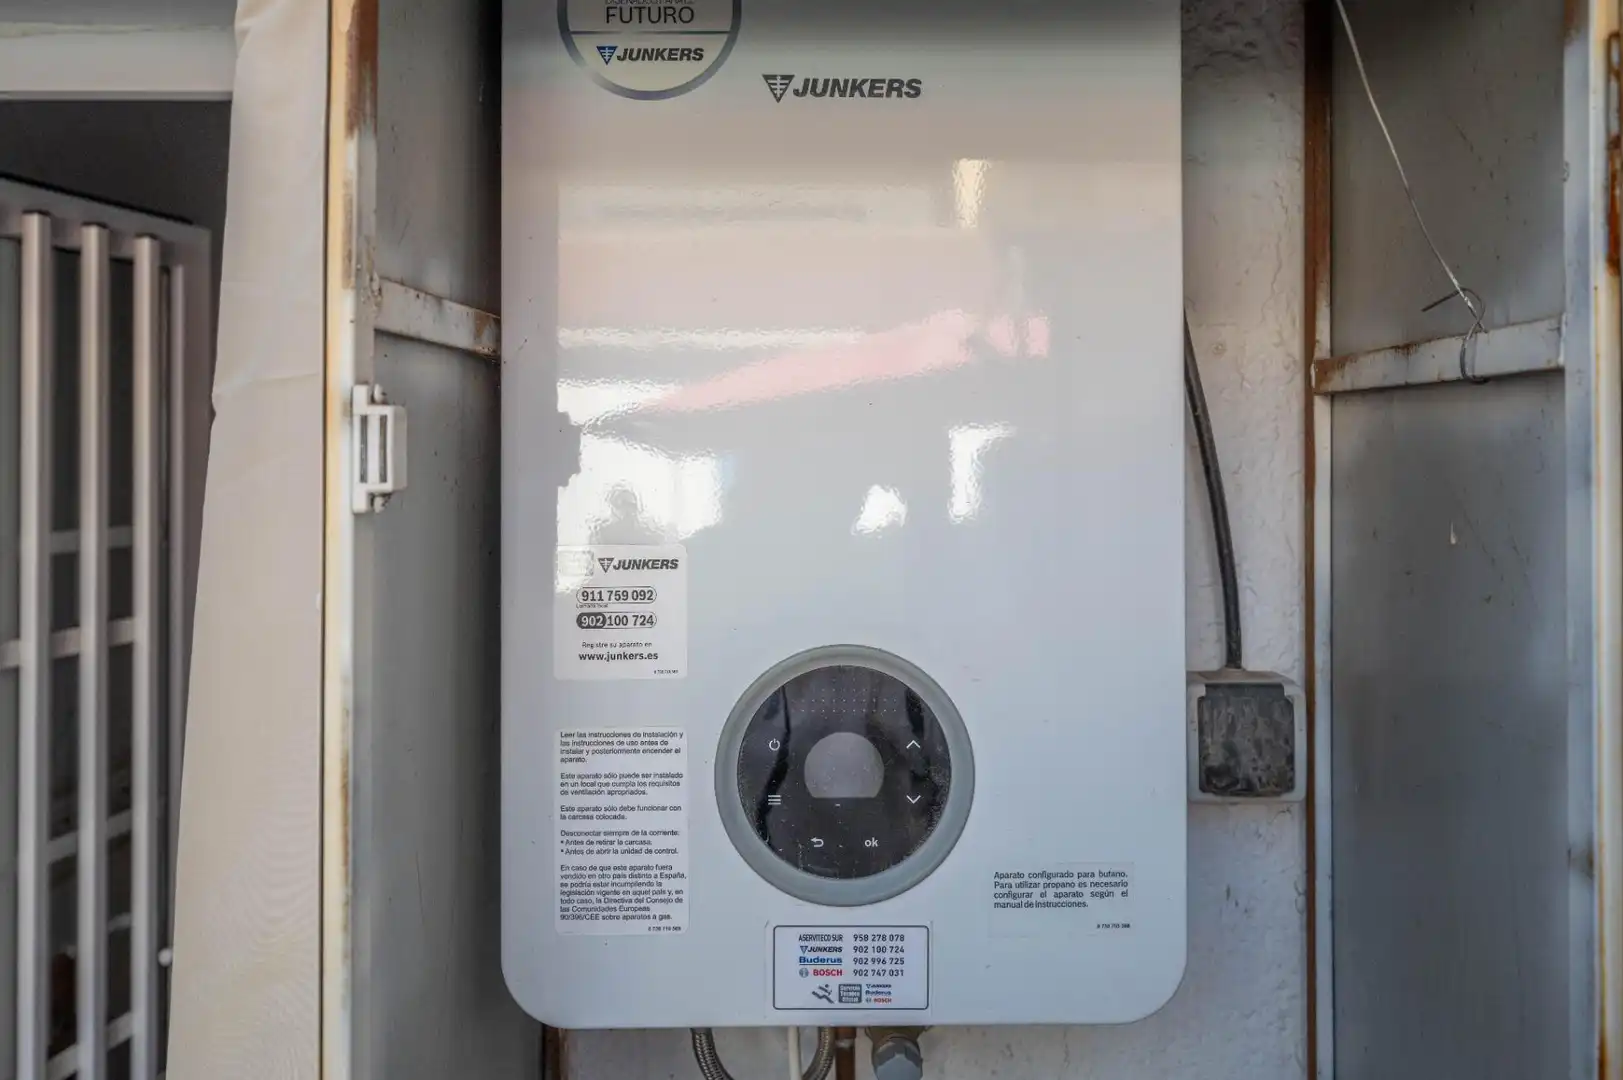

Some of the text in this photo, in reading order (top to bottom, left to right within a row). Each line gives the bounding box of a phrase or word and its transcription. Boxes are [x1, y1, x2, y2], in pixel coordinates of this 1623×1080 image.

[605, 6, 695, 24] FUTURO
[617, 47, 704, 62] JUNKERS
[792, 78, 922, 99] JUNKERS
[613, 559, 679, 570] JUNKERS
[581, 590, 654, 602] 911 759 092
[581, 615, 654, 626] 902 100 724
[578, 652, 659, 662] www.junkers.es
[649, 780, 680, 788] requisitos
[863, 837, 879, 848] ok
[660, 872, 687, 880] España,
[994, 870, 1128, 880] Aparato configurado para butano.
[994, 881, 1012, 889] Para
[1015, 881, 1041, 889] utilizar
[560, 889, 595, 897] legislación
[596, 889, 620, 897] vigente
[994, 891, 1034, 900] configurar
[1053, 891, 1084, 899] aparato
[1090, 891, 1114, 899] según
[1035, 900, 1088, 908] instrucciones.
[853, 945, 868, 953] 902
[871, 945, 887, 953] 100
[889, 945, 904, 953] 724
[799, 956, 904, 965] Buderus 902 996 725
